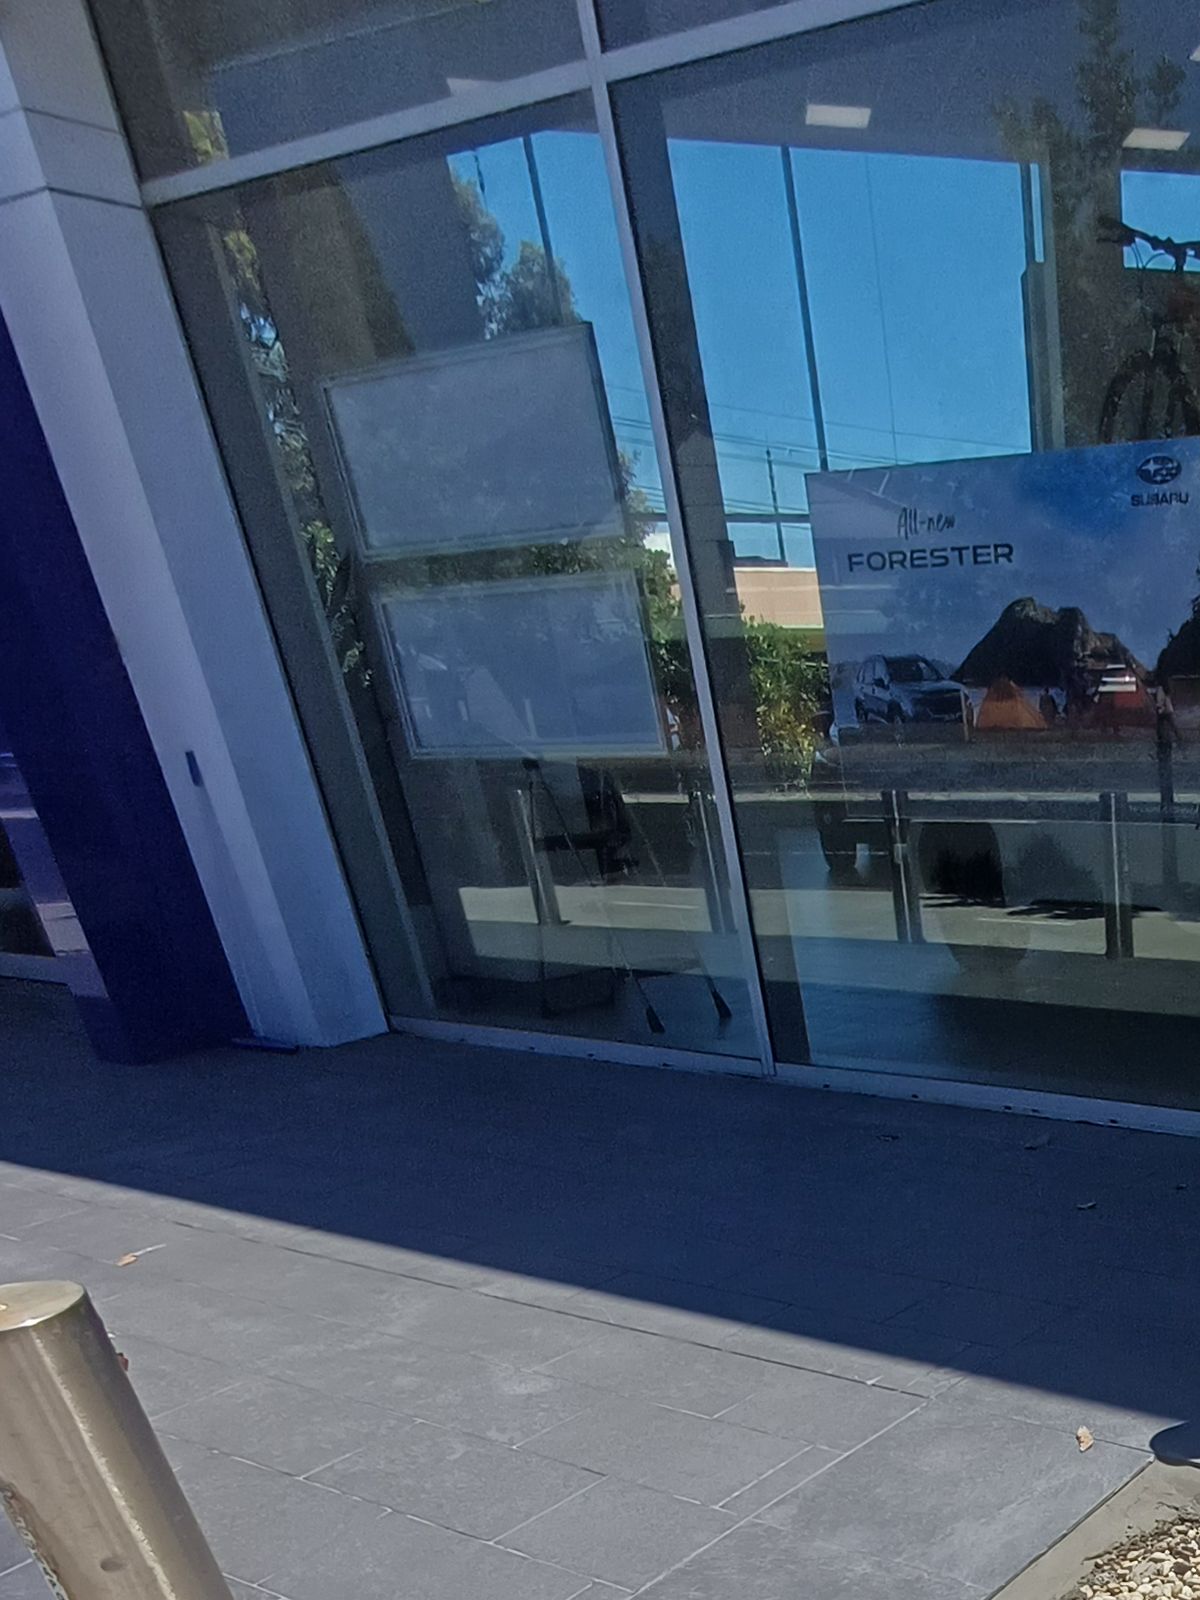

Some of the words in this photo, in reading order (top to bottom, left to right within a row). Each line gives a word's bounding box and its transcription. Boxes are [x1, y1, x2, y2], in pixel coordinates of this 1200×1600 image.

[1130, 492, 1189, 507] SUBARU
[898, 506, 956, 541] All-new
[847, 542, 1014, 572] FORESTER
